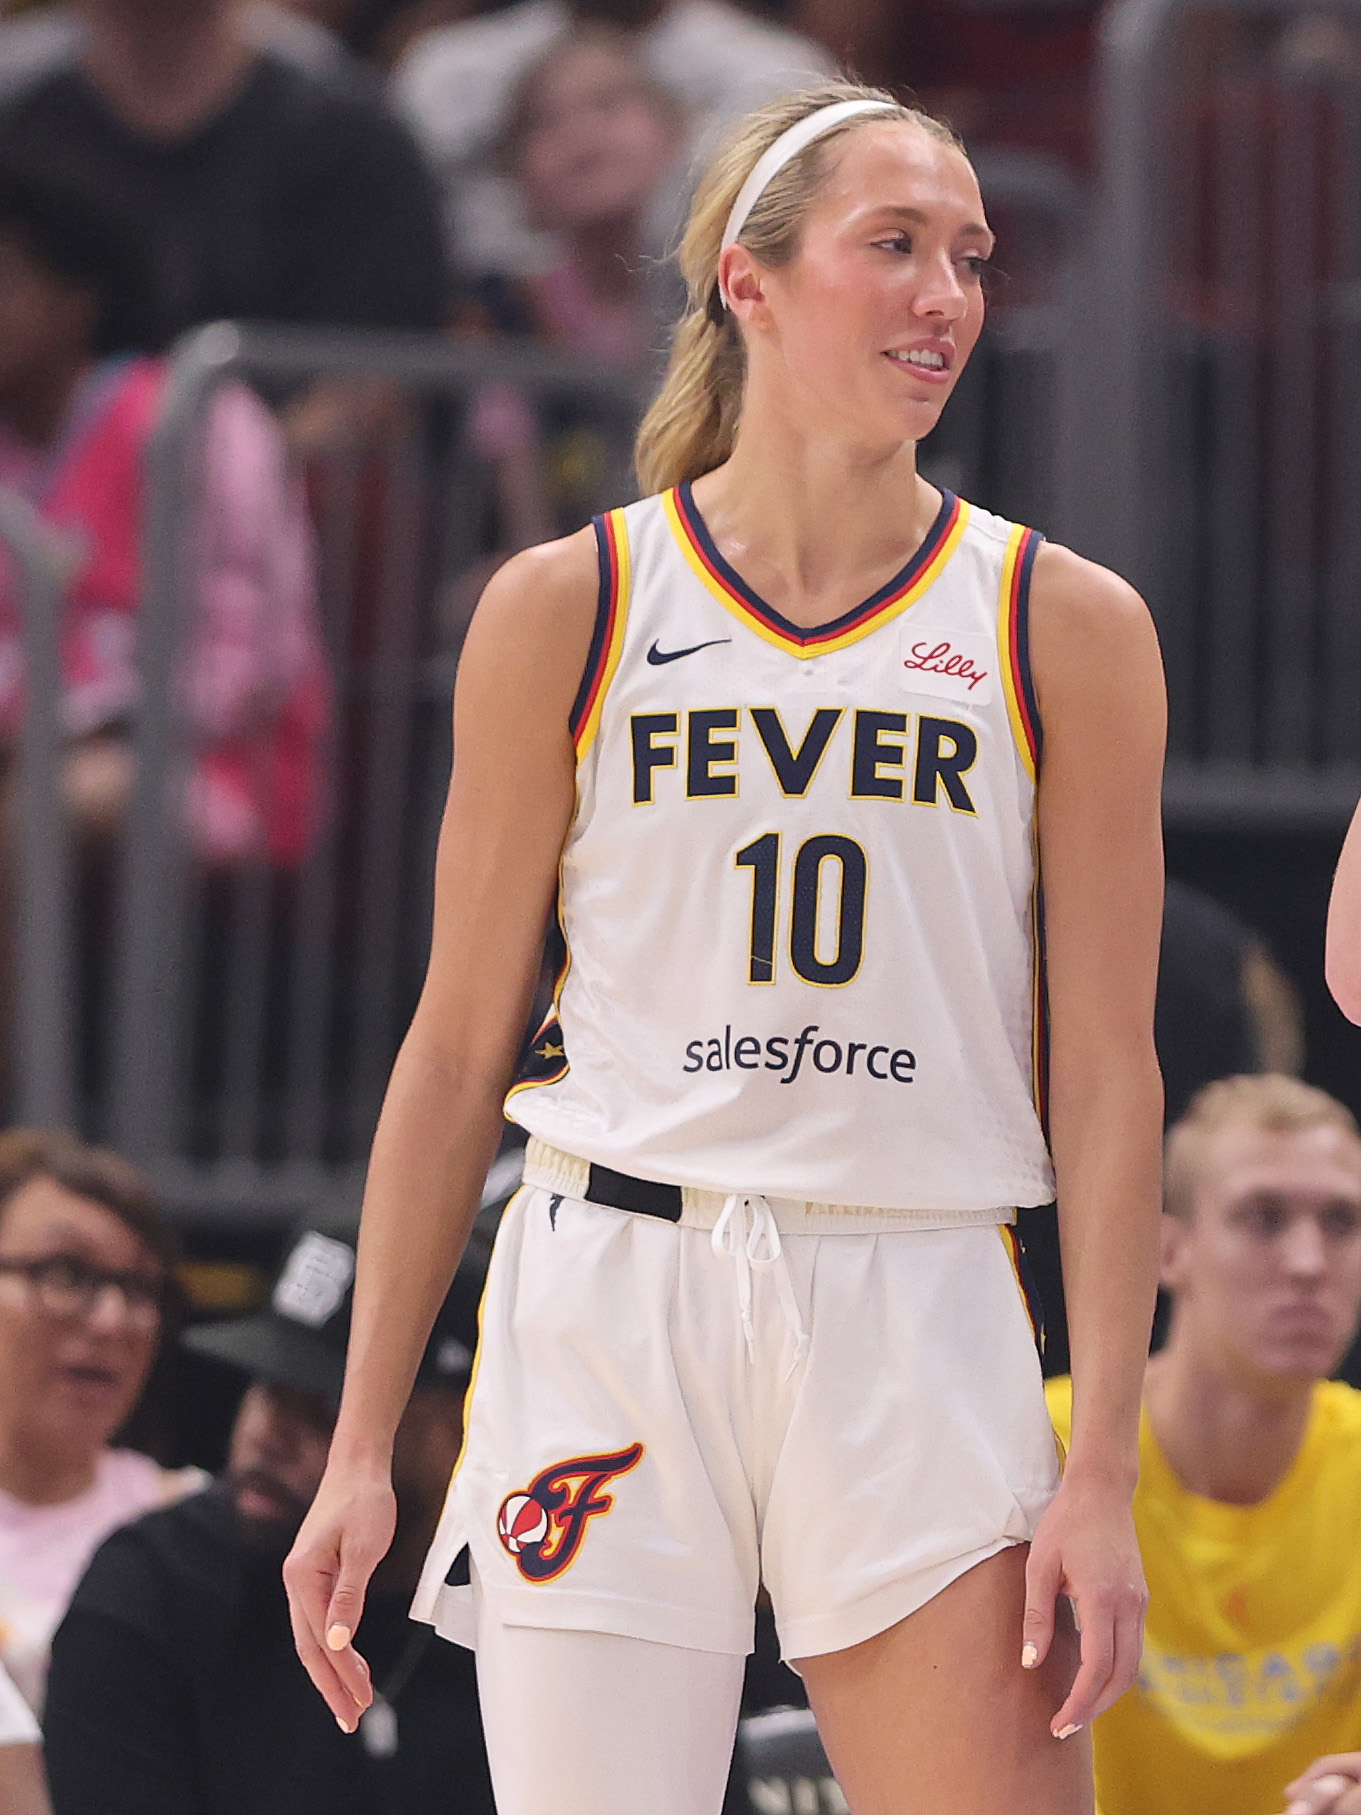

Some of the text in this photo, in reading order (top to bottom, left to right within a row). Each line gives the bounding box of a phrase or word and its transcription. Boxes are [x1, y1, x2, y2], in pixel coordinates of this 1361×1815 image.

[903, 641, 988, 690] Lilly
[629, 706, 980, 818] FEVER
[733, 831, 869, 989] 10
[682, 1025, 917, 1085] salesforce
